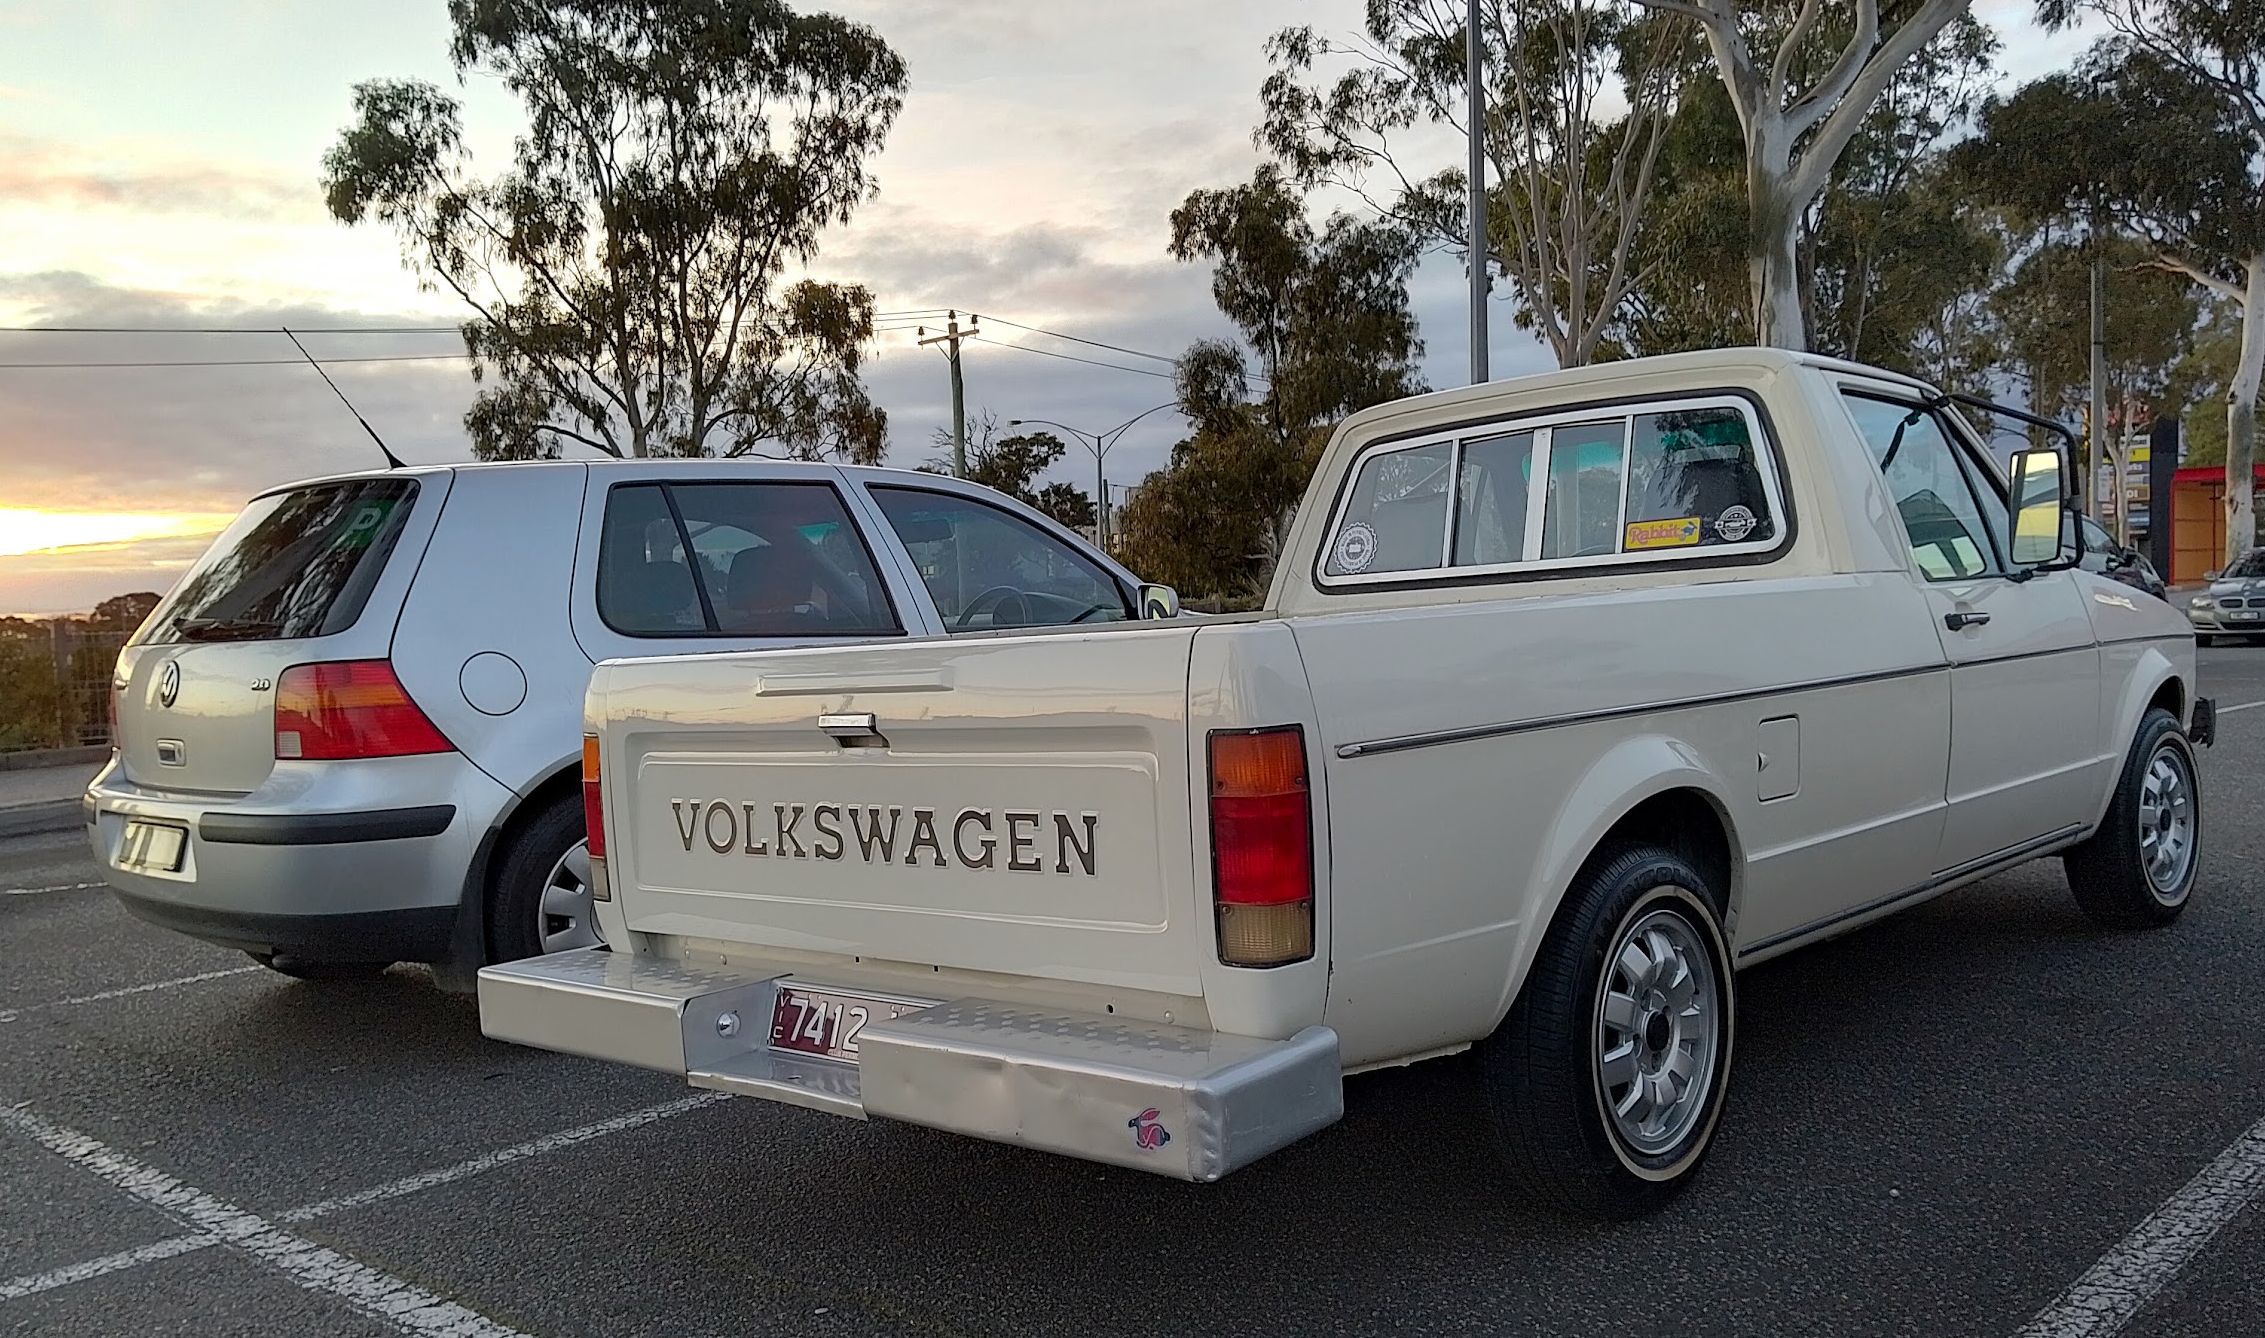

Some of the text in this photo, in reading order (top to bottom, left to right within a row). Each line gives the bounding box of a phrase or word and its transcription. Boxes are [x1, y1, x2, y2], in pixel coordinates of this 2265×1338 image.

[338, 507, 382, 545] P
[671, 798, 1101, 876] VOLKSWAGEN
[773, 995, 790, 1038] VIC
[790, 997, 868, 1052] 7412
